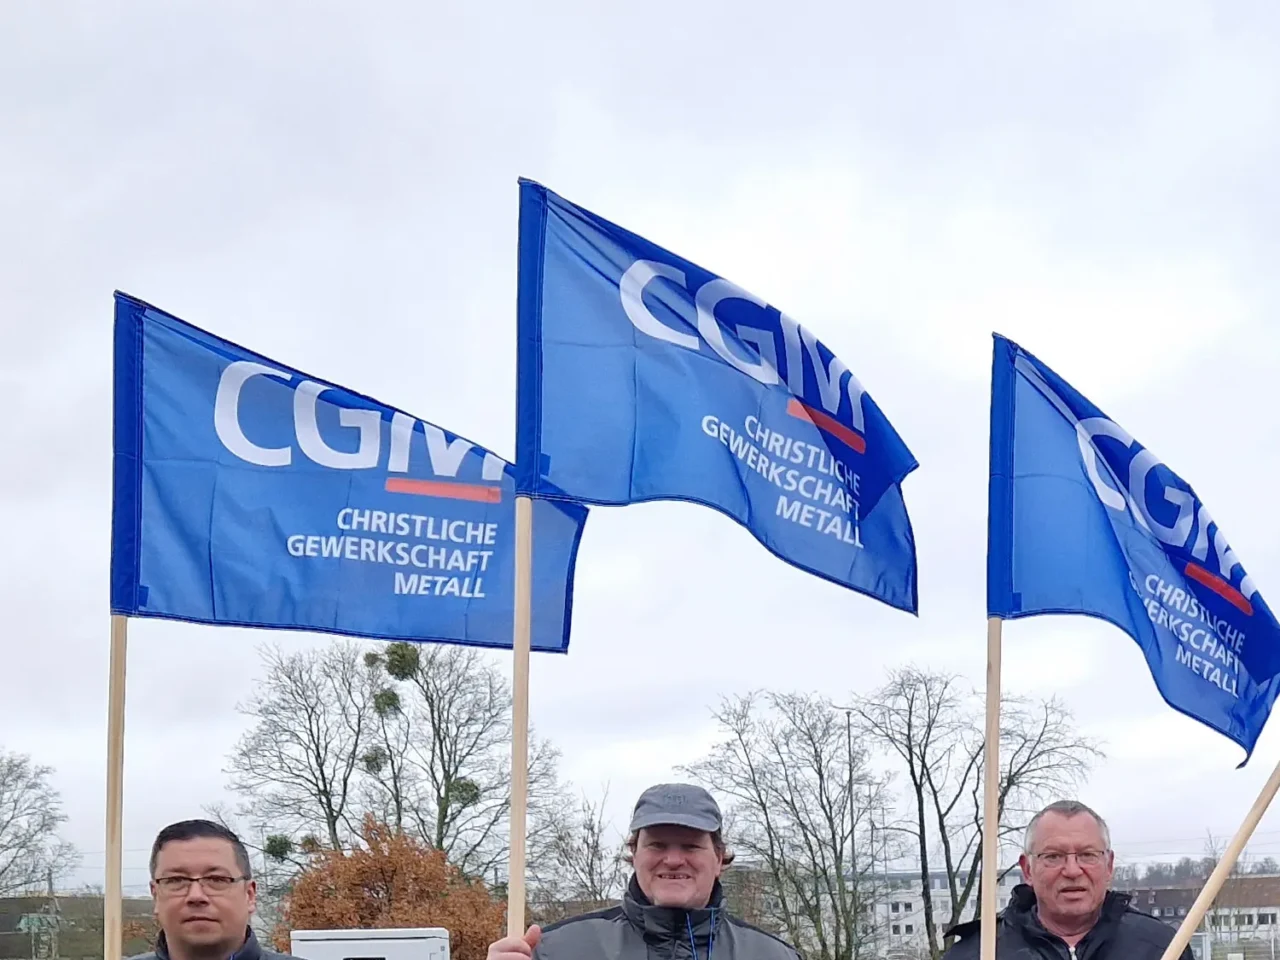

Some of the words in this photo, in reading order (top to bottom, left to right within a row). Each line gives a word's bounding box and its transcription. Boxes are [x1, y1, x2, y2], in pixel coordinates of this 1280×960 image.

[619, 259, 865, 434] CGM
[214, 360, 506, 481] CGM
[701, 415, 861, 520] GEWERKSCHAFT
[744, 415, 861, 496] CHRISTLICHE
[286, 534, 493, 573] GEWERKSCHAFT
[337, 507, 498, 546] CHRISTLICHE
[775, 495, 864, 549] METALL
[393, 571, 486, 599] METALL
[1145, 573, 1245, 651] CHRISTLICHE
[1175, 643, 1239, 699] METALL
